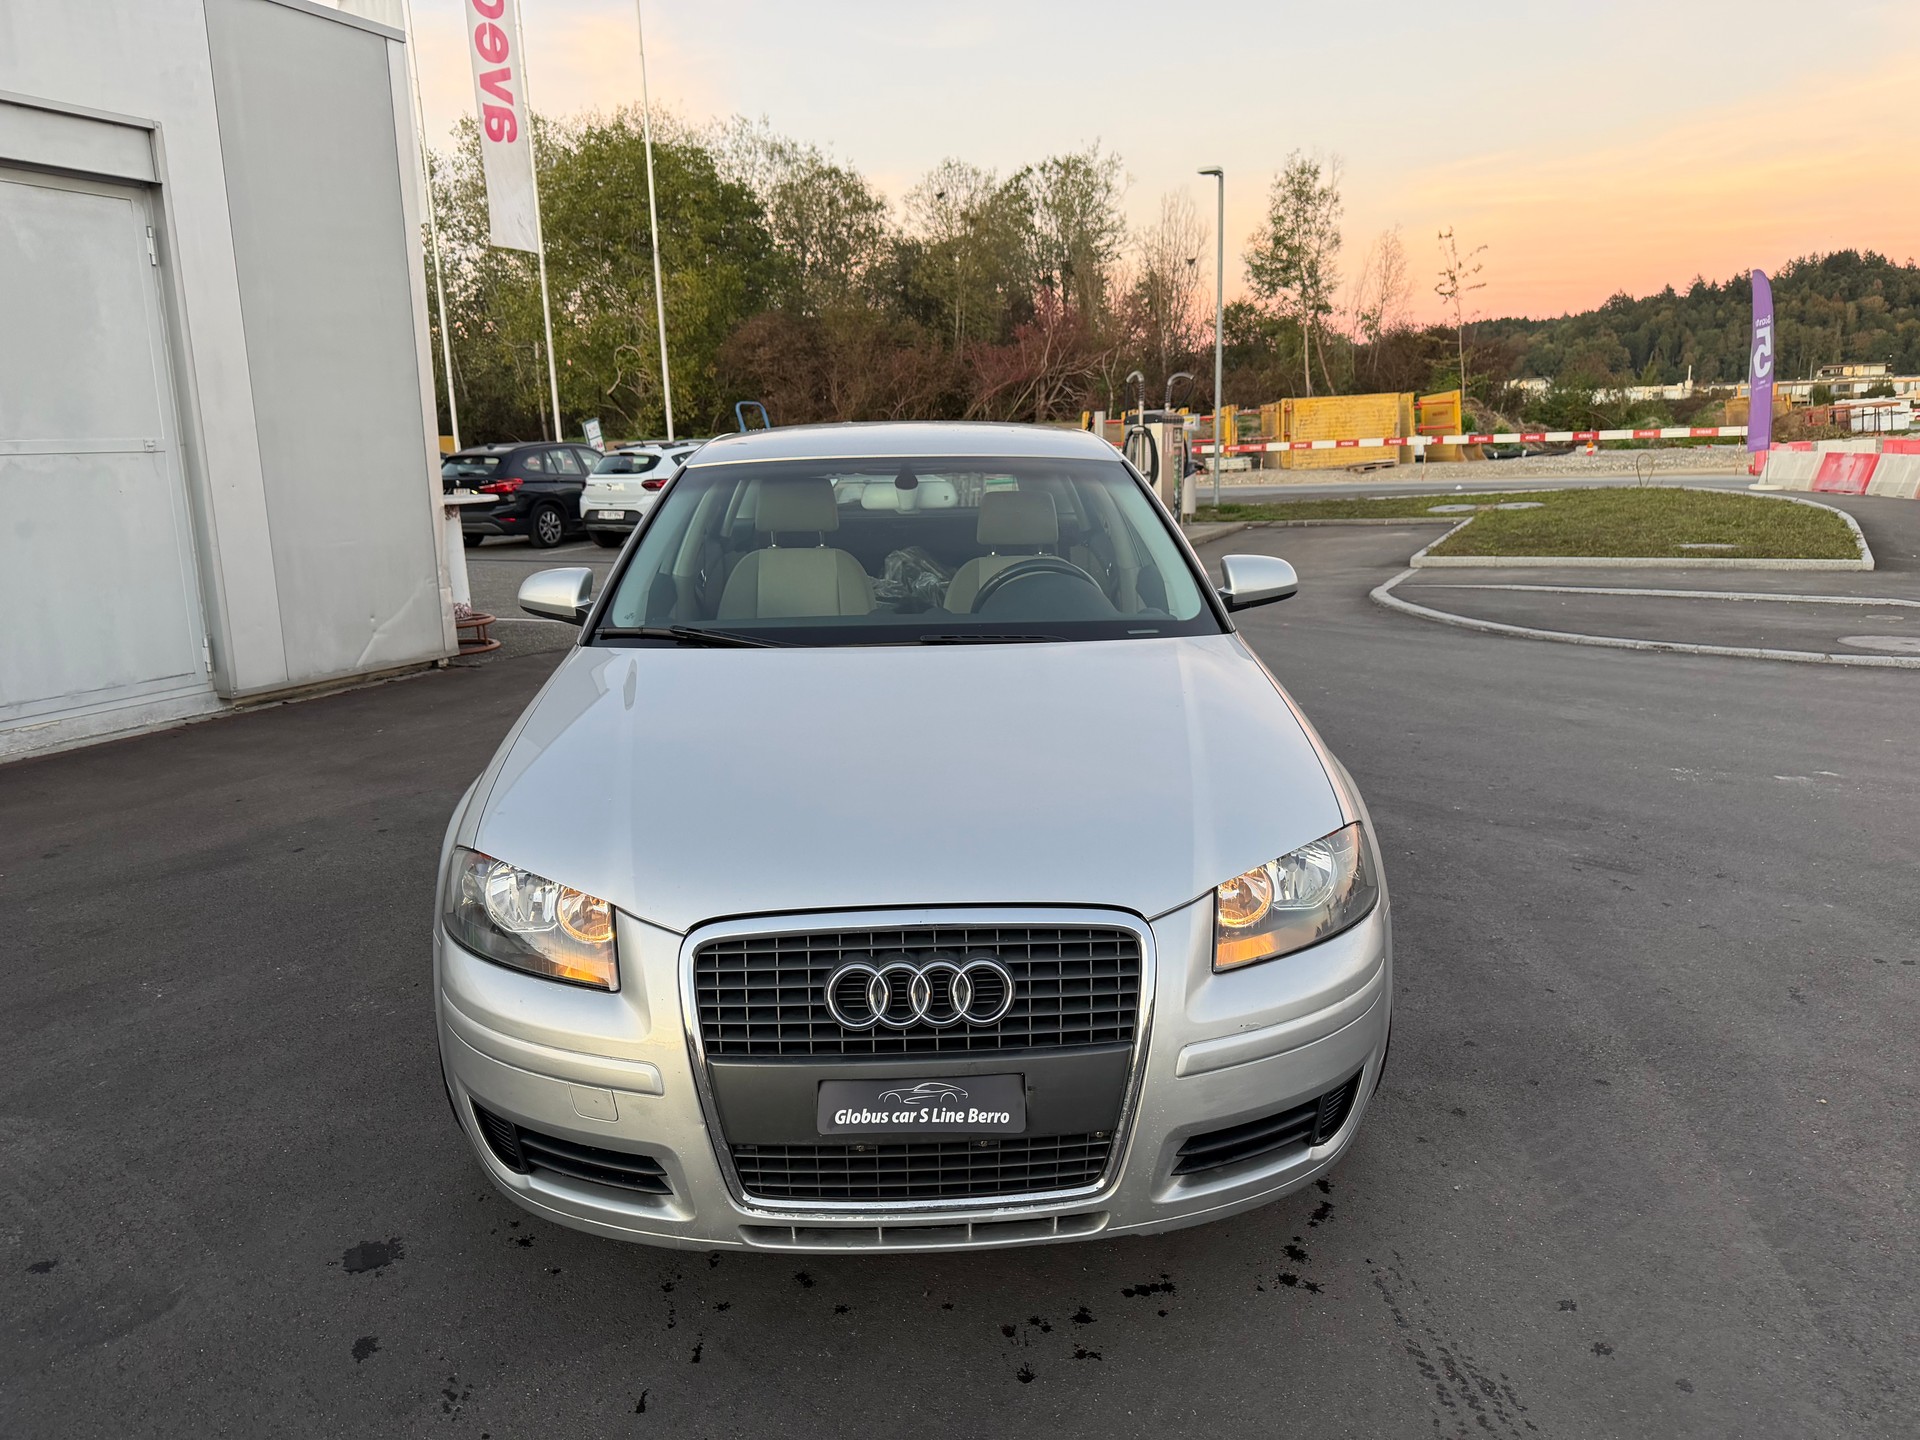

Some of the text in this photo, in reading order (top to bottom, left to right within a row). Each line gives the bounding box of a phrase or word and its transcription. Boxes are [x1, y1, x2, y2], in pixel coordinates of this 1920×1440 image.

[834, 1107, 1010, 1125] Globus car S Line Berro
